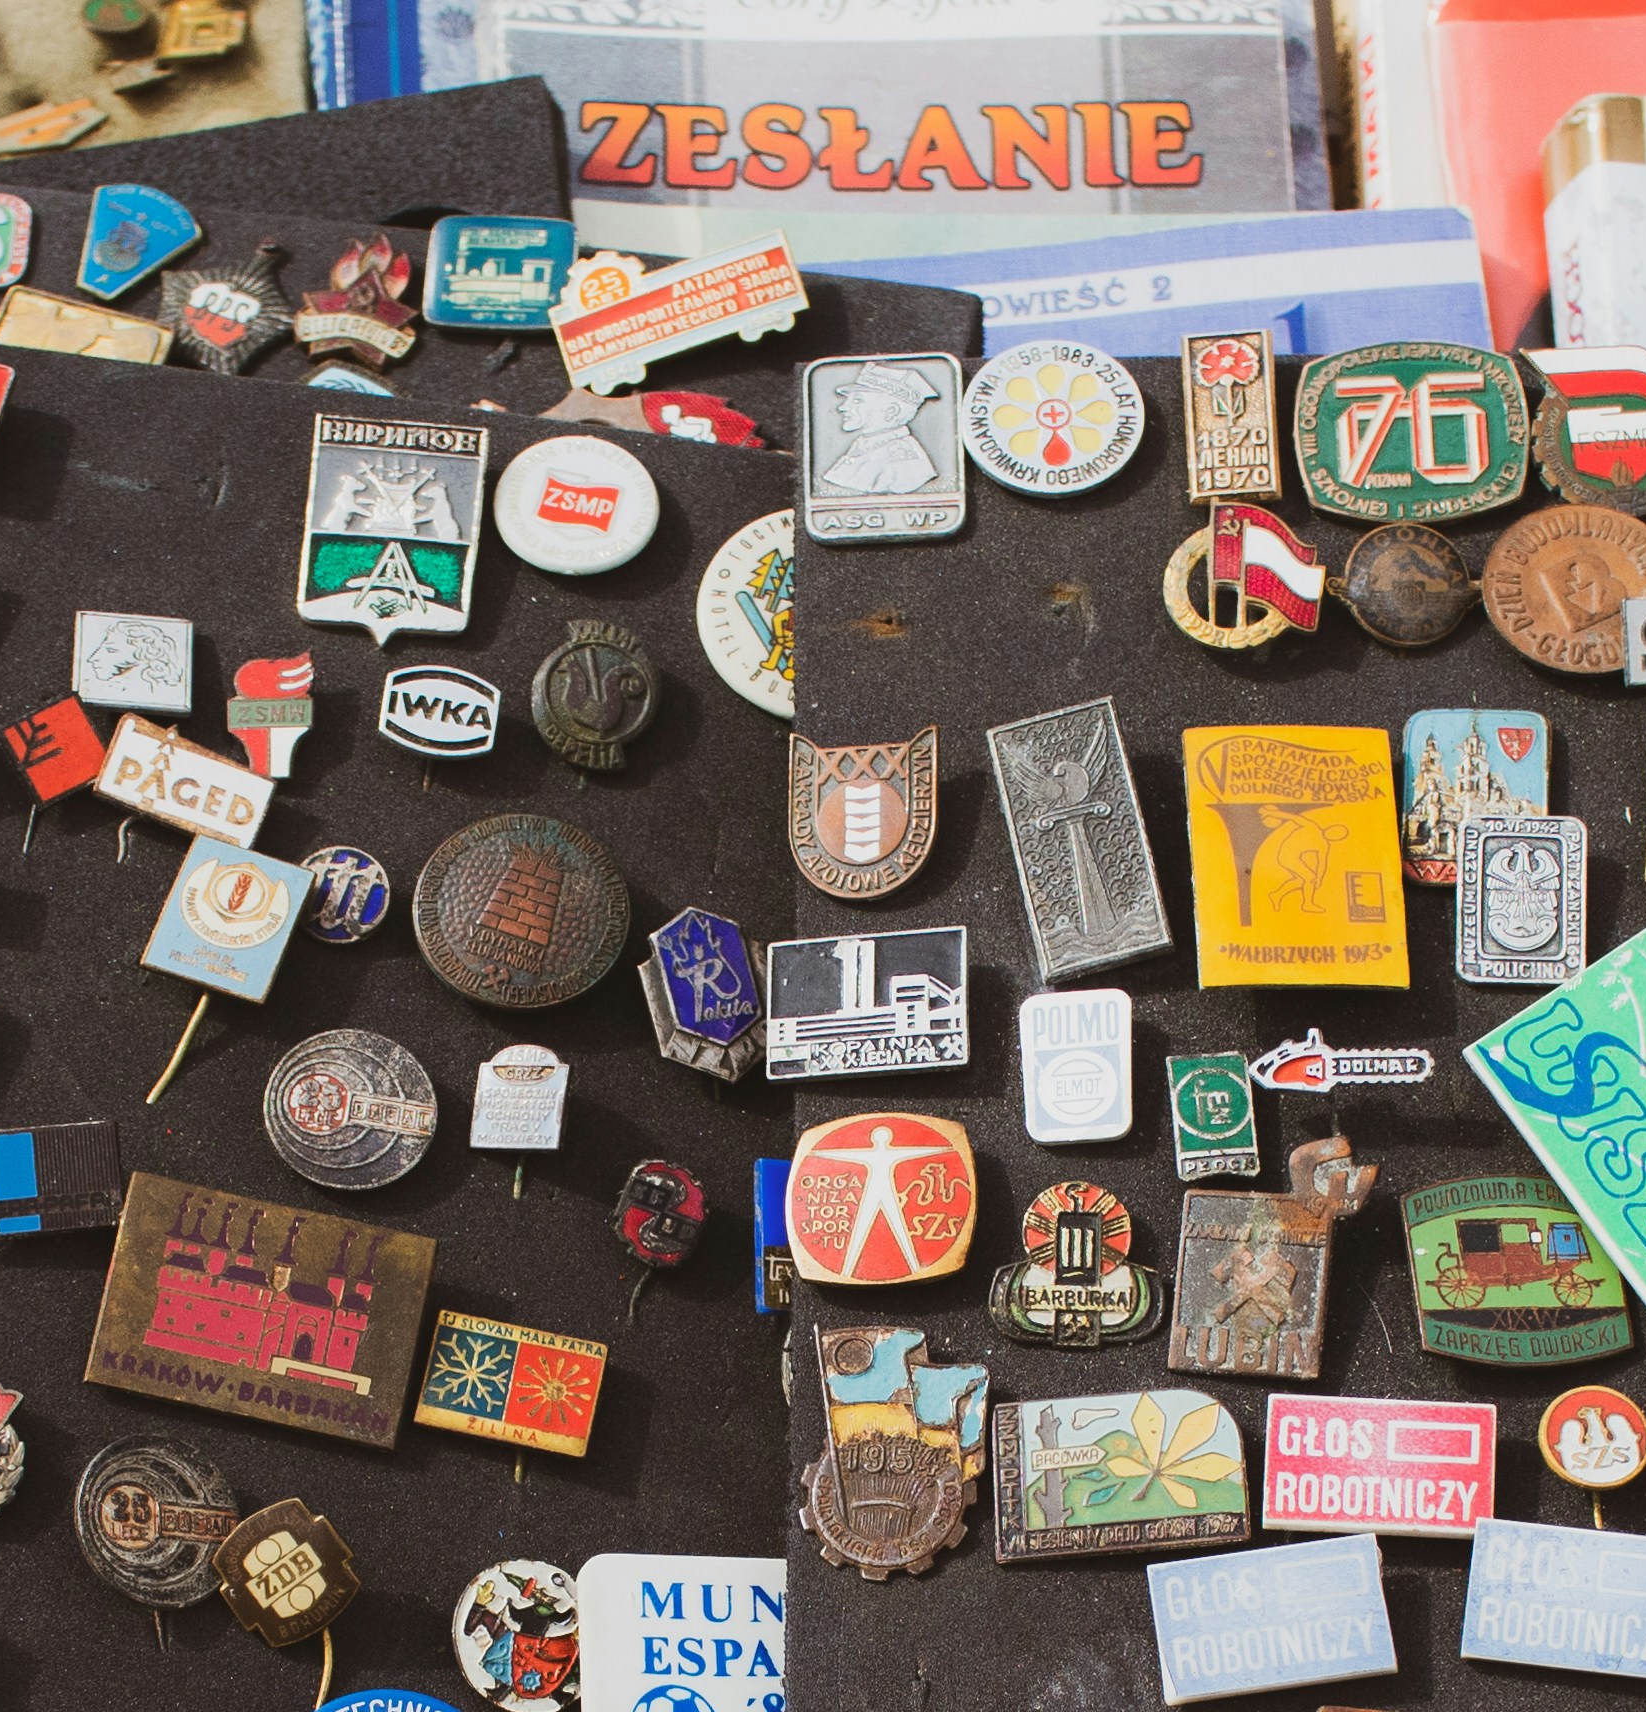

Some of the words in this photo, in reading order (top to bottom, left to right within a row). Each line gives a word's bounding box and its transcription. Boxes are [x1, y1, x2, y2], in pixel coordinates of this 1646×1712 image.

[578, 98, 1203, 193] ZESŁANIE
[580, 271, 623, 300] 25
[1197, 427, 1267, 448] 1870
[1197, 444, 1270, 468] ЛЕНИН
[1198, 466, 1271, 488] 1970
[544, 485, 615, 518] ZSMP
[820, 513, 886, 532] ASG
[906, 511, 949, 530] WP
[236, 703, 306, 724] ZSMW
[386, 689, 494, 732] IWKA
[1229, 736, 1356, 768] SPARTAKIADA
[792, 749, 817, 848] ZAKŁADY
[805, 847, 900, 894] AZOTOWE
[897, 746, 931, 874] KĘDZIERZYN
[1227, 944, 1339, 966] WAŁBRZYCH
[1344, 942, 1385, 963] 1973
[1480, 960, 1566, 980] POLICHNO
[1031, 1000, 1122, 1046] POLMO
[1055, 1077, 1101, 1097] ELMOT
[800, 1175, 862, 1191] ORGA
[807, 1204, 849, 1220] TOR
[1176, 1327, 1320, 1371] LUBIN
[1432, 1323, 1523, 1359] ZAPRZĘG
[1529, 1324, 1621, 1356] DWORSKI
[466, 1415, 540, 1444] ŽILINA
[1279, 1416, 1373, 1460] GŁOS
[1034, 1448, 1100, 1467] BACÓWKA
[1570, 1445, 1632, 1471] SZS
[1275, 1470, 1479, 1523] ROBOTNICZY
[253, 1549, 316, 1602] ŽDB
[1484, 1534, 1581, 1589] GŁOS
[1164, 1566, 1257, 1622] GŁOS
[1173, 1615, 1378, 1680] ROBOTNICZY
